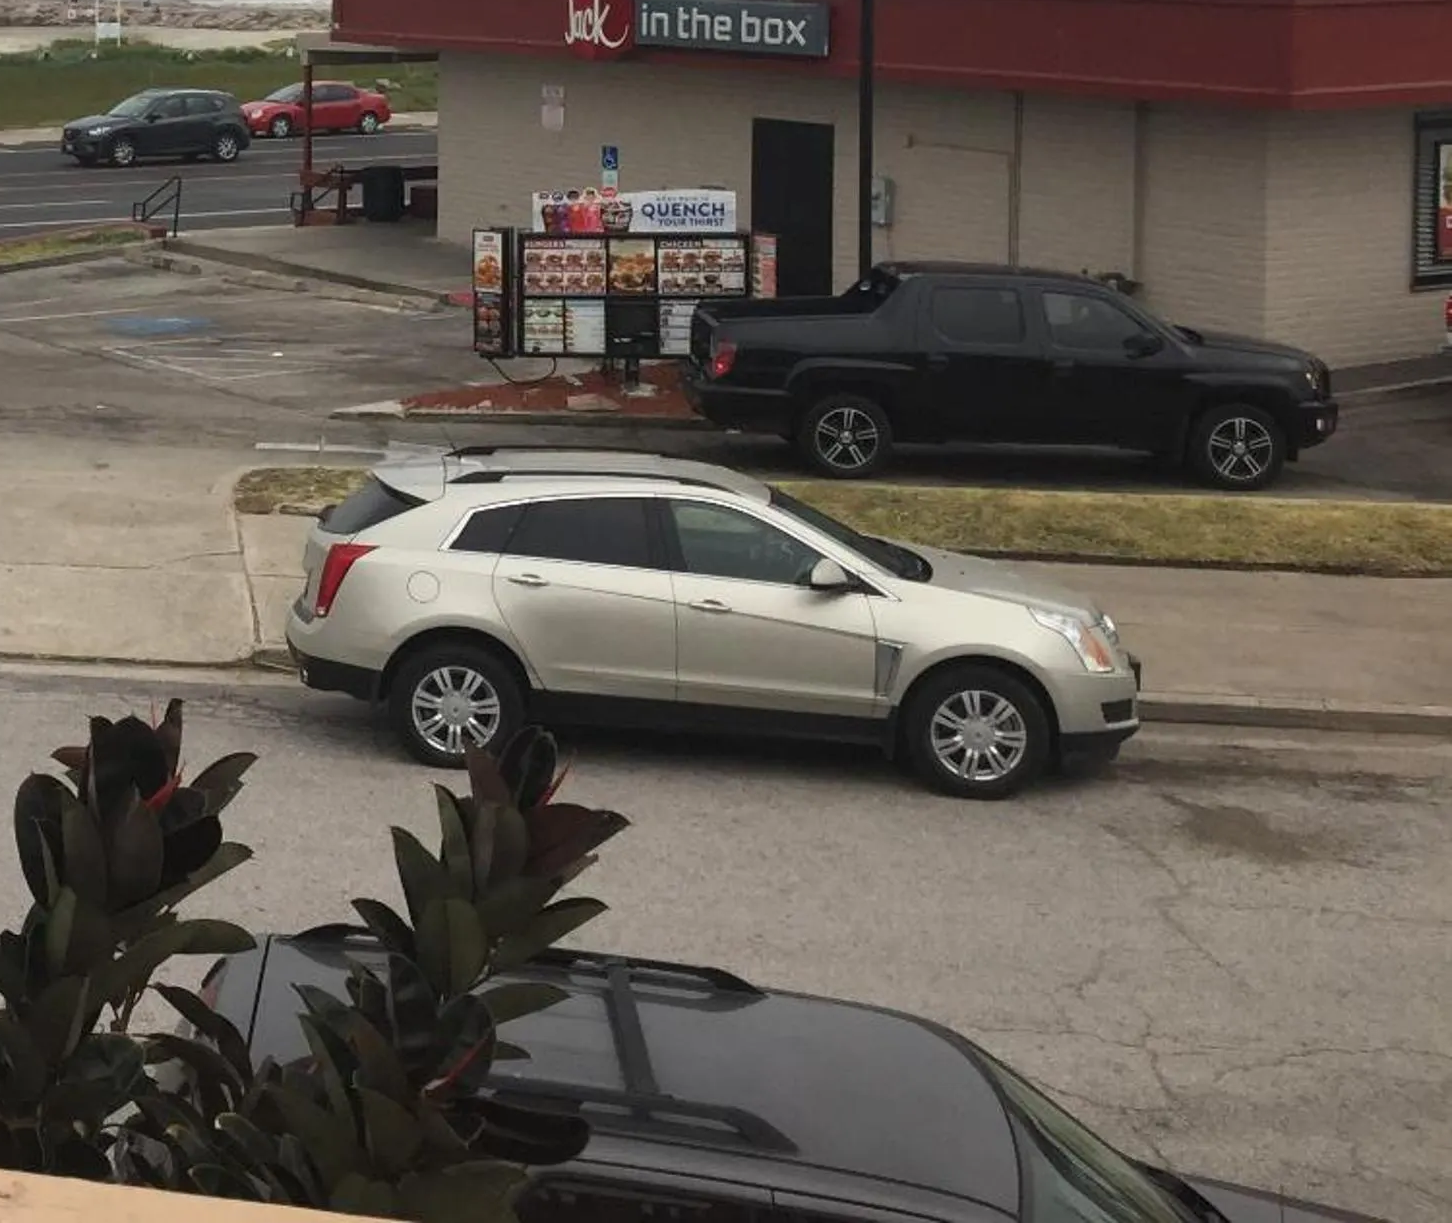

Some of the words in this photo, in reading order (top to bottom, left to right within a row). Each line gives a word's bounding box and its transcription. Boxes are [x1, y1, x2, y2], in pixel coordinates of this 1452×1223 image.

[641, 3, 670, 37] in
[677, 6, 733, 42] the
[740, 9, 807, 47] box
[641, 202, 726, 220] QUENCH
[657, 218, 687, 228] YOUR
[690, 218, 725, 228] THIRST
